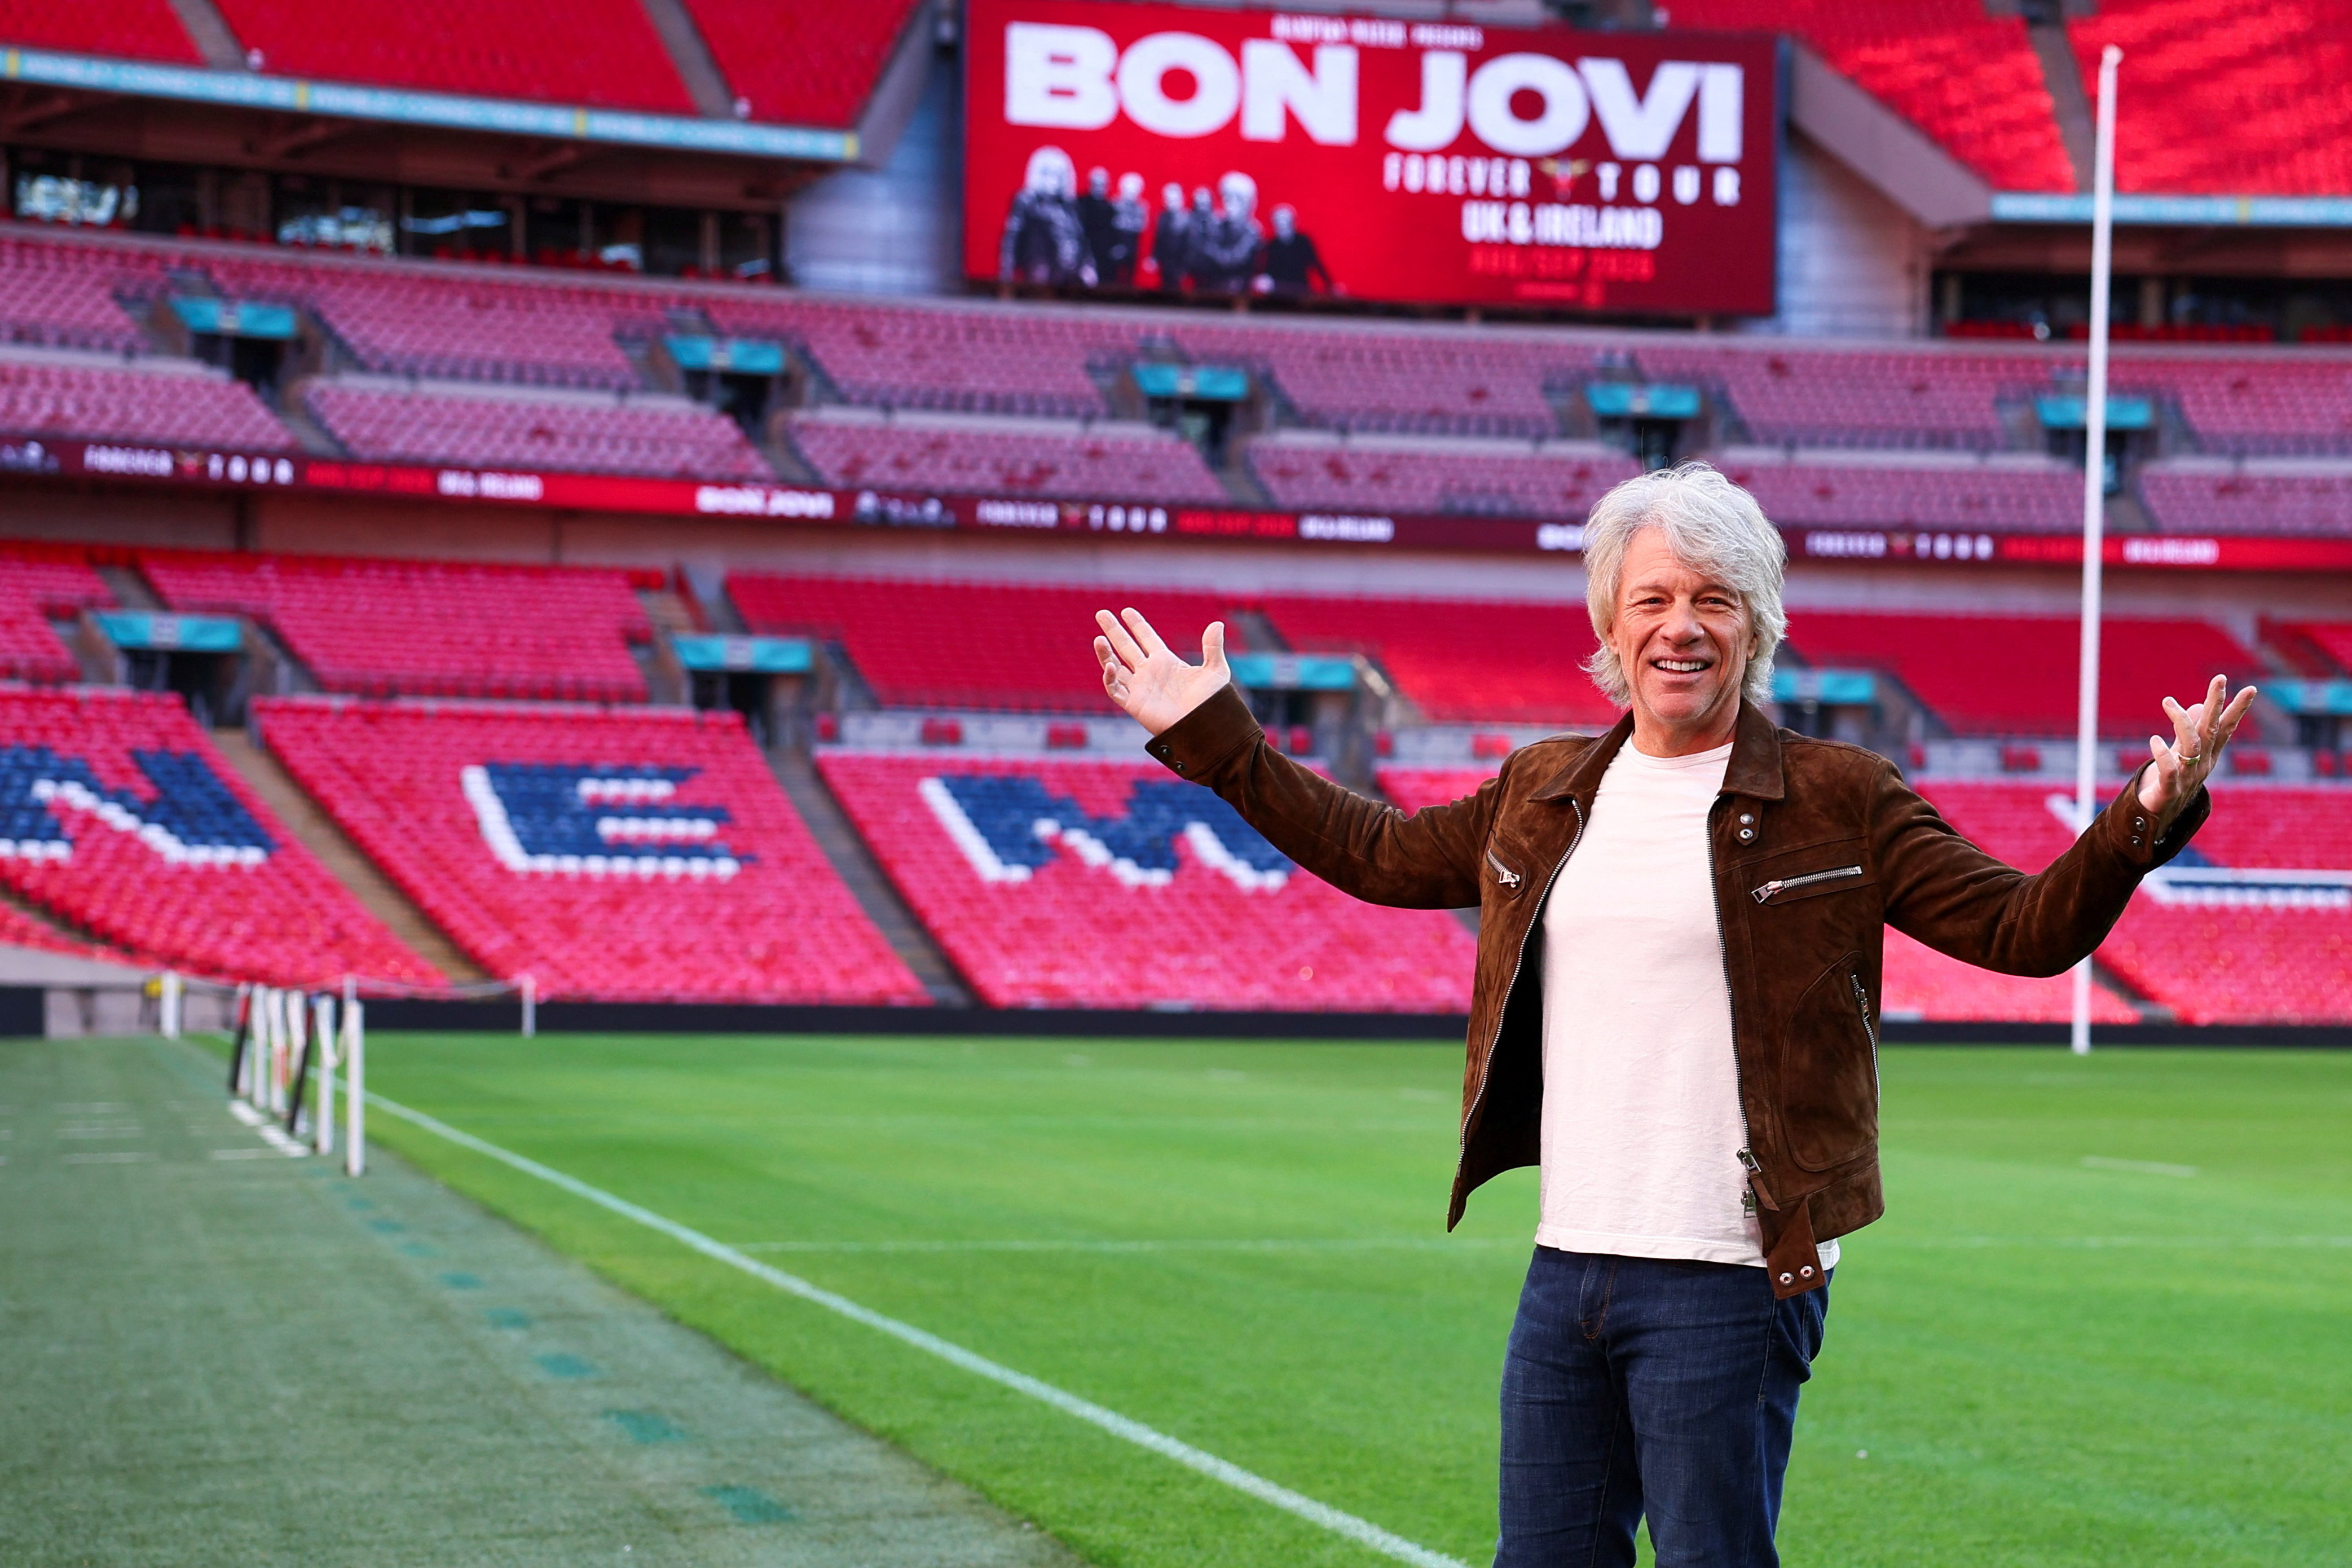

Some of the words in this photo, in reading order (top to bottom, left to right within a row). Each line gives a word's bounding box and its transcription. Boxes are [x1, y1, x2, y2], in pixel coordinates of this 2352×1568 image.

[1005, 20, 1358, 146] BON
[1384, 50, 1744, 163] JOVI
[1383, 152, 1531, 198] FOREVER
[1595, 162, 1741, 206] TOUR
